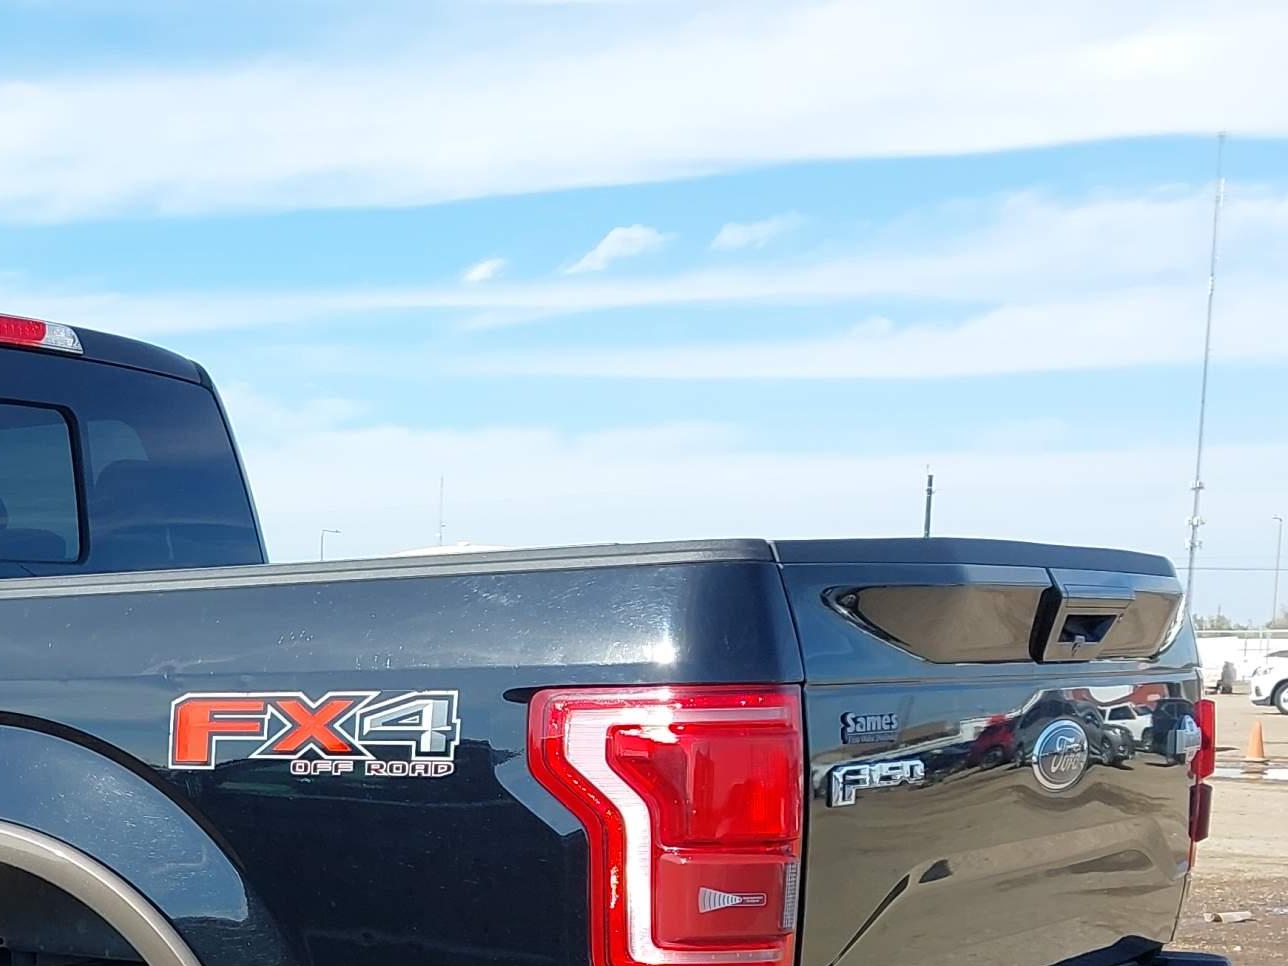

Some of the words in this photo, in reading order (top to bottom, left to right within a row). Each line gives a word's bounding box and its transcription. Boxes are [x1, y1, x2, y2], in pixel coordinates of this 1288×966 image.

[168, 690, 461, 770] FX4
[846, 712, 899, 733] Sames
[290, 760, 354, 775] OFF
[364, 761, 455, 777] ROAD
